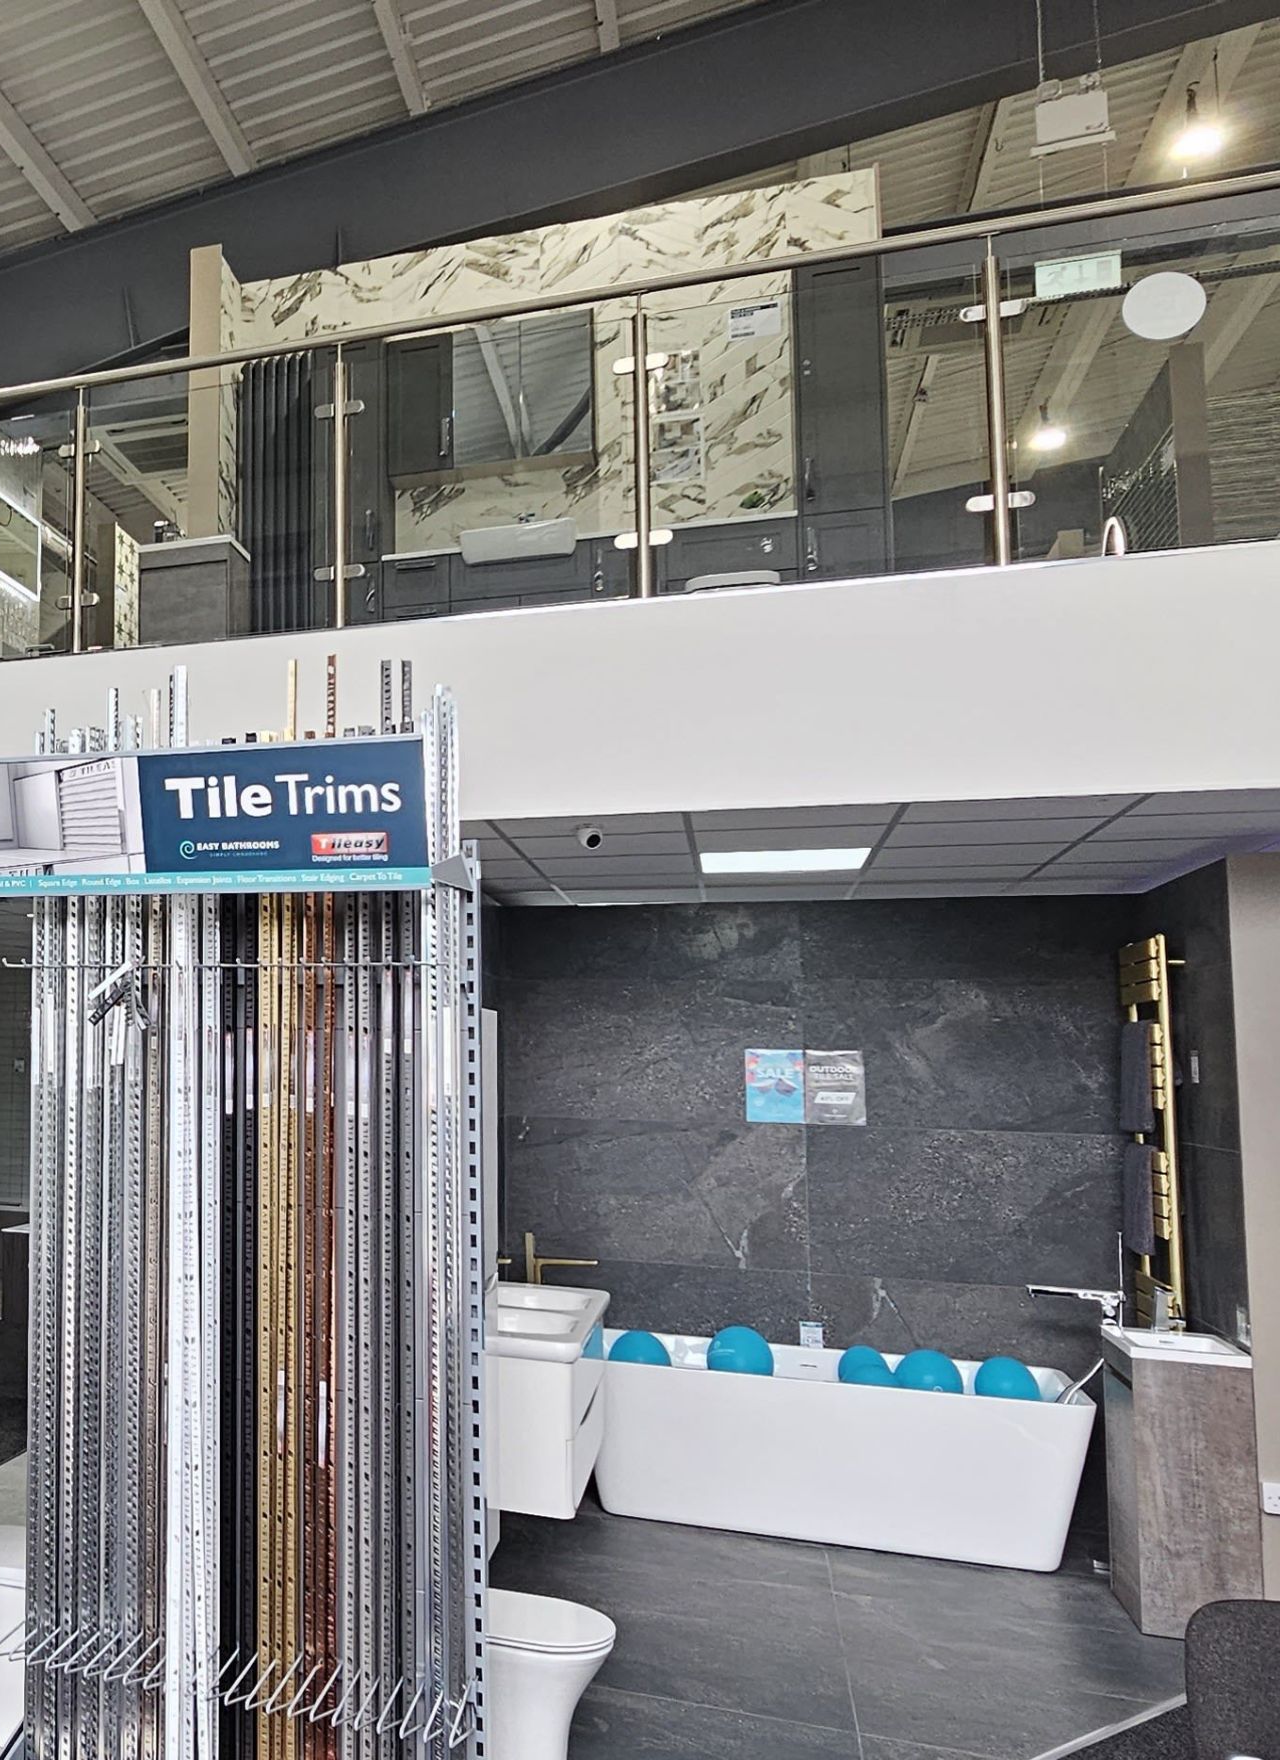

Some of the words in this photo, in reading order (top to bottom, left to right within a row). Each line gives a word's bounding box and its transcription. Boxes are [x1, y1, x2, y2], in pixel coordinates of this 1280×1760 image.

[164, 775, 272, 819] Tile
[275, 773, 402, 816] Trims
[196, 842, 220, 851] EASY
[221, 840, 280, 850] BATHROOMS
[319, 836, 385, 849] Tileasy
[312, 855, 342, 863] Designed
[61, 879, 78, 888] Edge
[105, 878, 121, 887] Edge
[176, 875, 211, 886] Expansion
[257, 874, 297, 883] Transitions
[319, 872, 345, 883] Edging
[349, 872, 377, 882] Carpet
[376, 871, 387, 881] To
[387, 871, 403, 881] Tile
[756, 1067, 795, 1079] SALE
